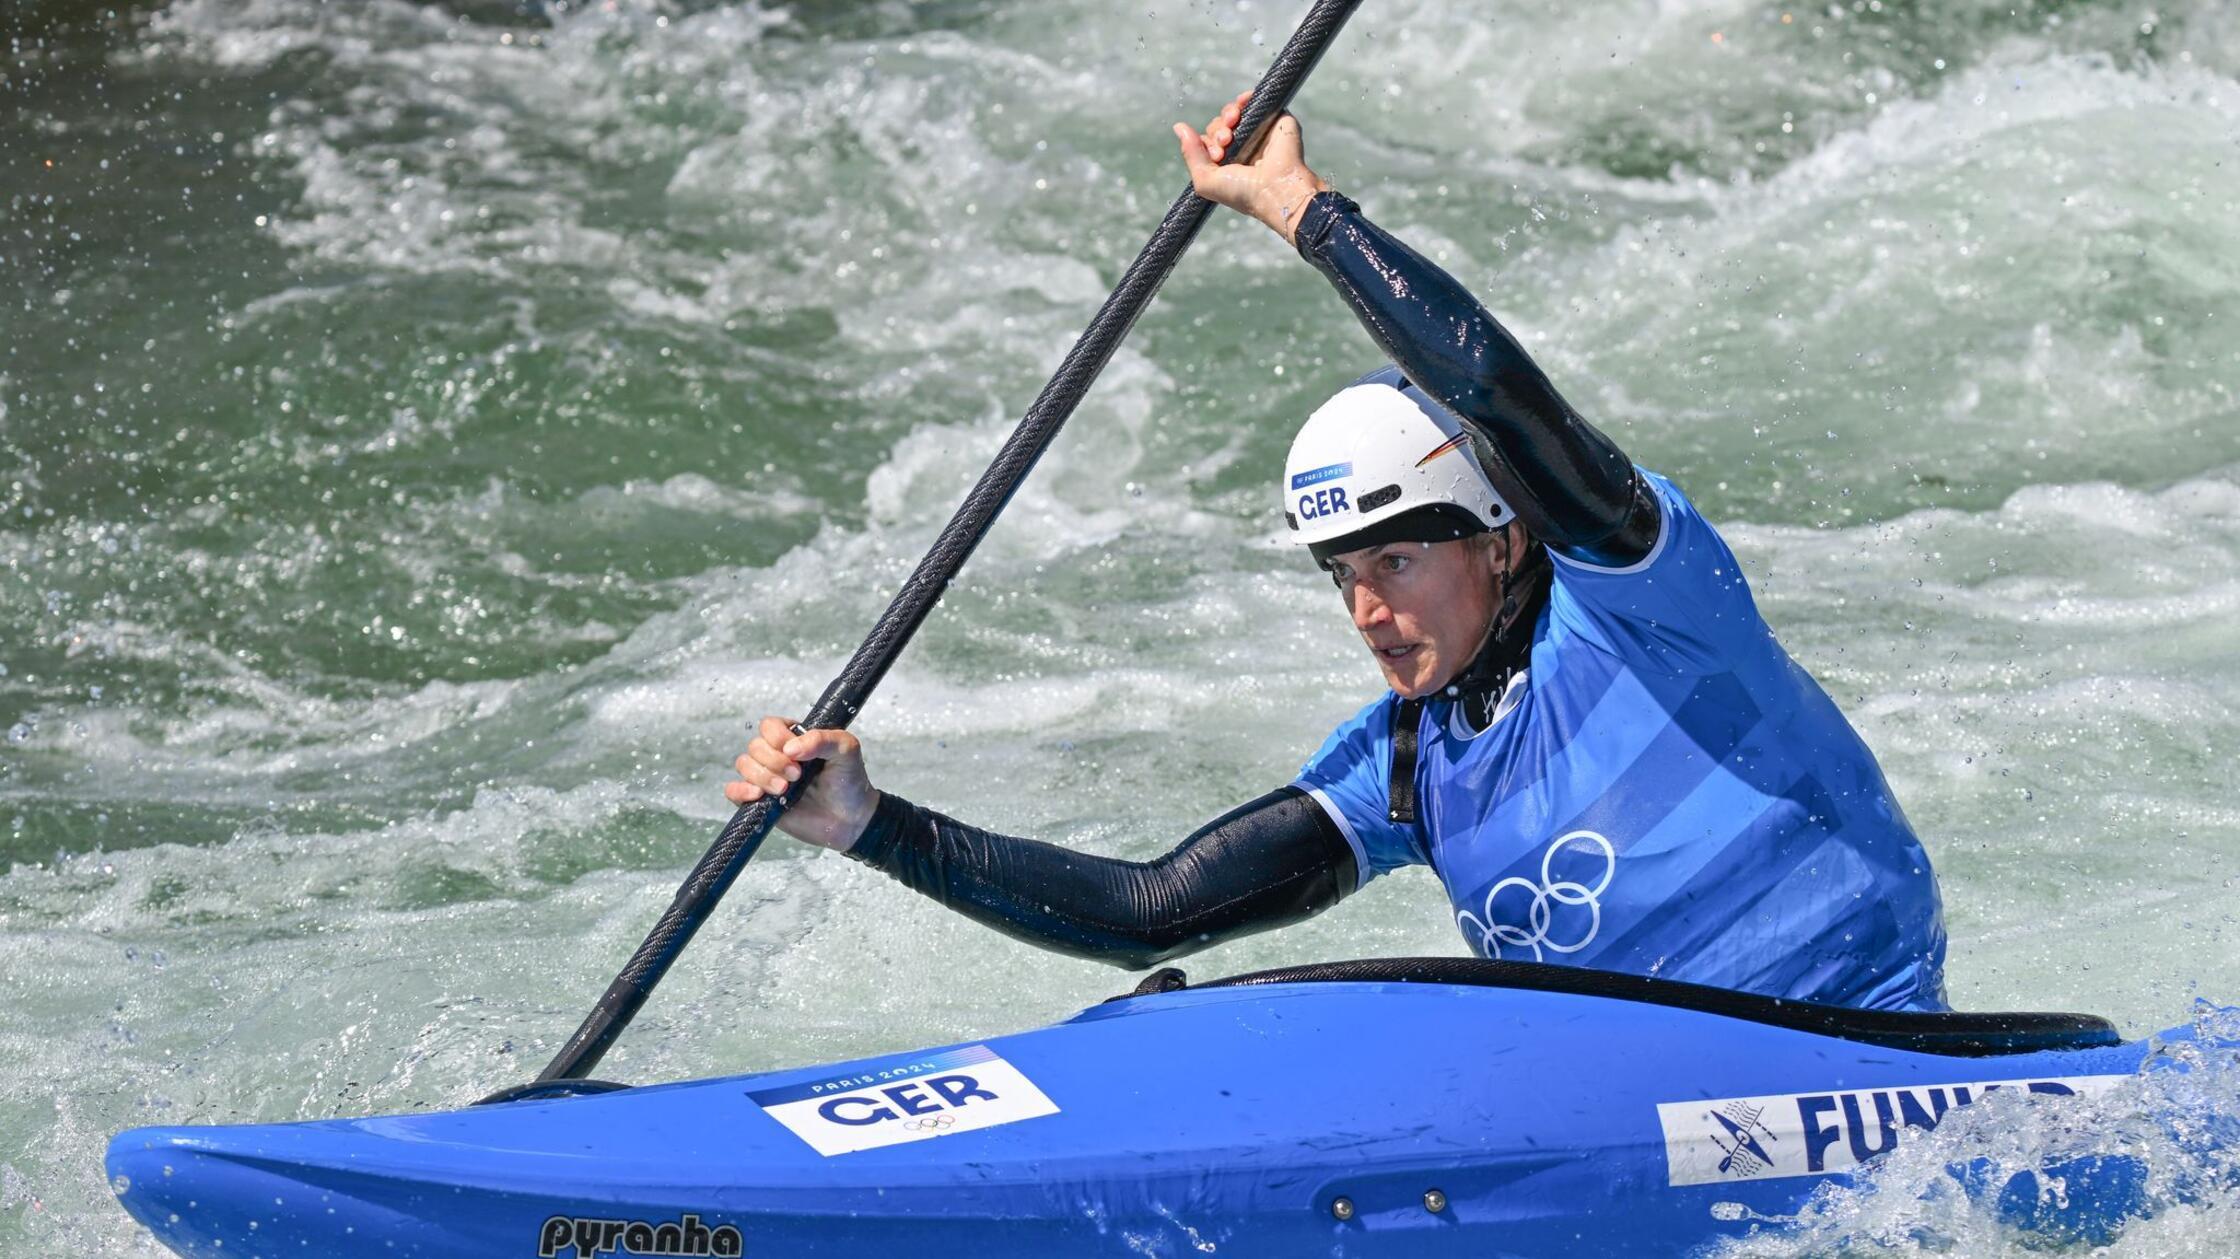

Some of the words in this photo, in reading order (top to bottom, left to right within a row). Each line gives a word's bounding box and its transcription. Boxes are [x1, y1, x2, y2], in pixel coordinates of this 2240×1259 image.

[1299, 487, 1350, 520] GER
[811, 1074, 874, 1093] PARIS
[879, 1062, 936, 1080] 2024
[818, 1075, 999, 1126] GER
[1797, 1085, 2001, 1172] FUN
[538, 1214, 743, 1259] pyranha
